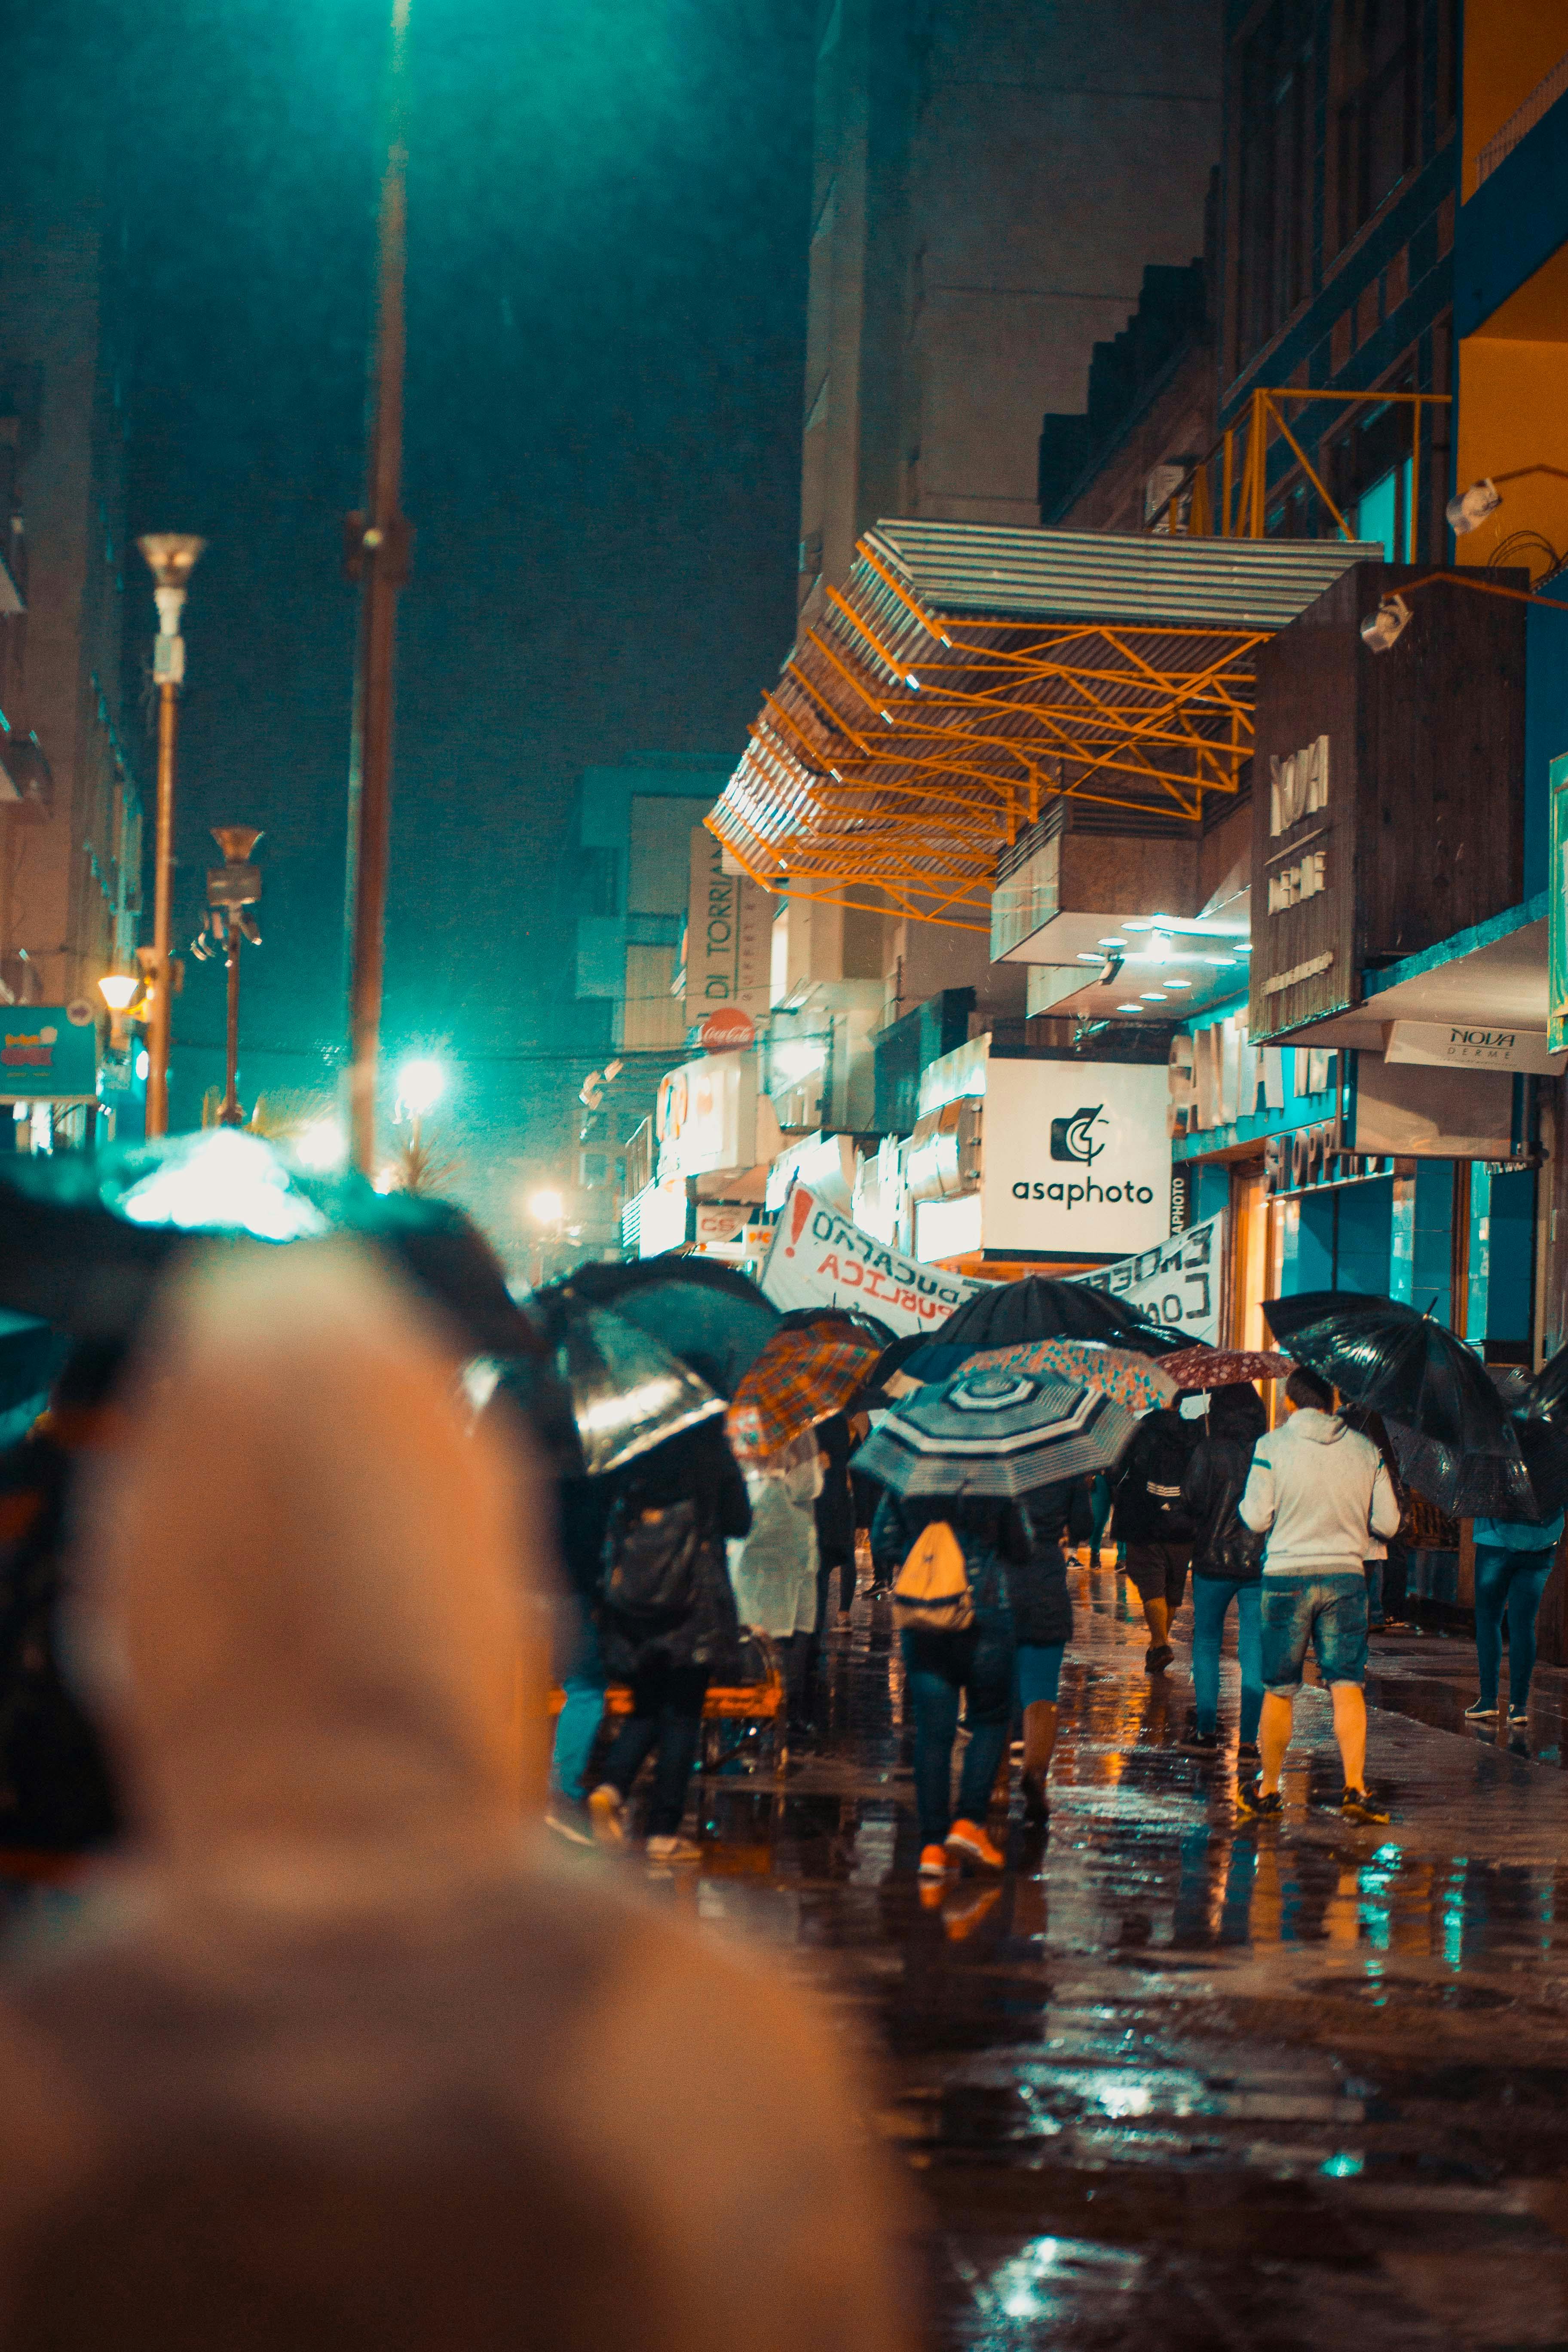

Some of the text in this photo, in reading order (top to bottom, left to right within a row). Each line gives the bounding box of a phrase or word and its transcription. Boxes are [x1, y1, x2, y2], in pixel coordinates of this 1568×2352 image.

[705, 975, 729, 999] DI
[1451, 1028, 1516, 1047] NOVA
[1012, 1176, 1153, 1210] asaphoto
